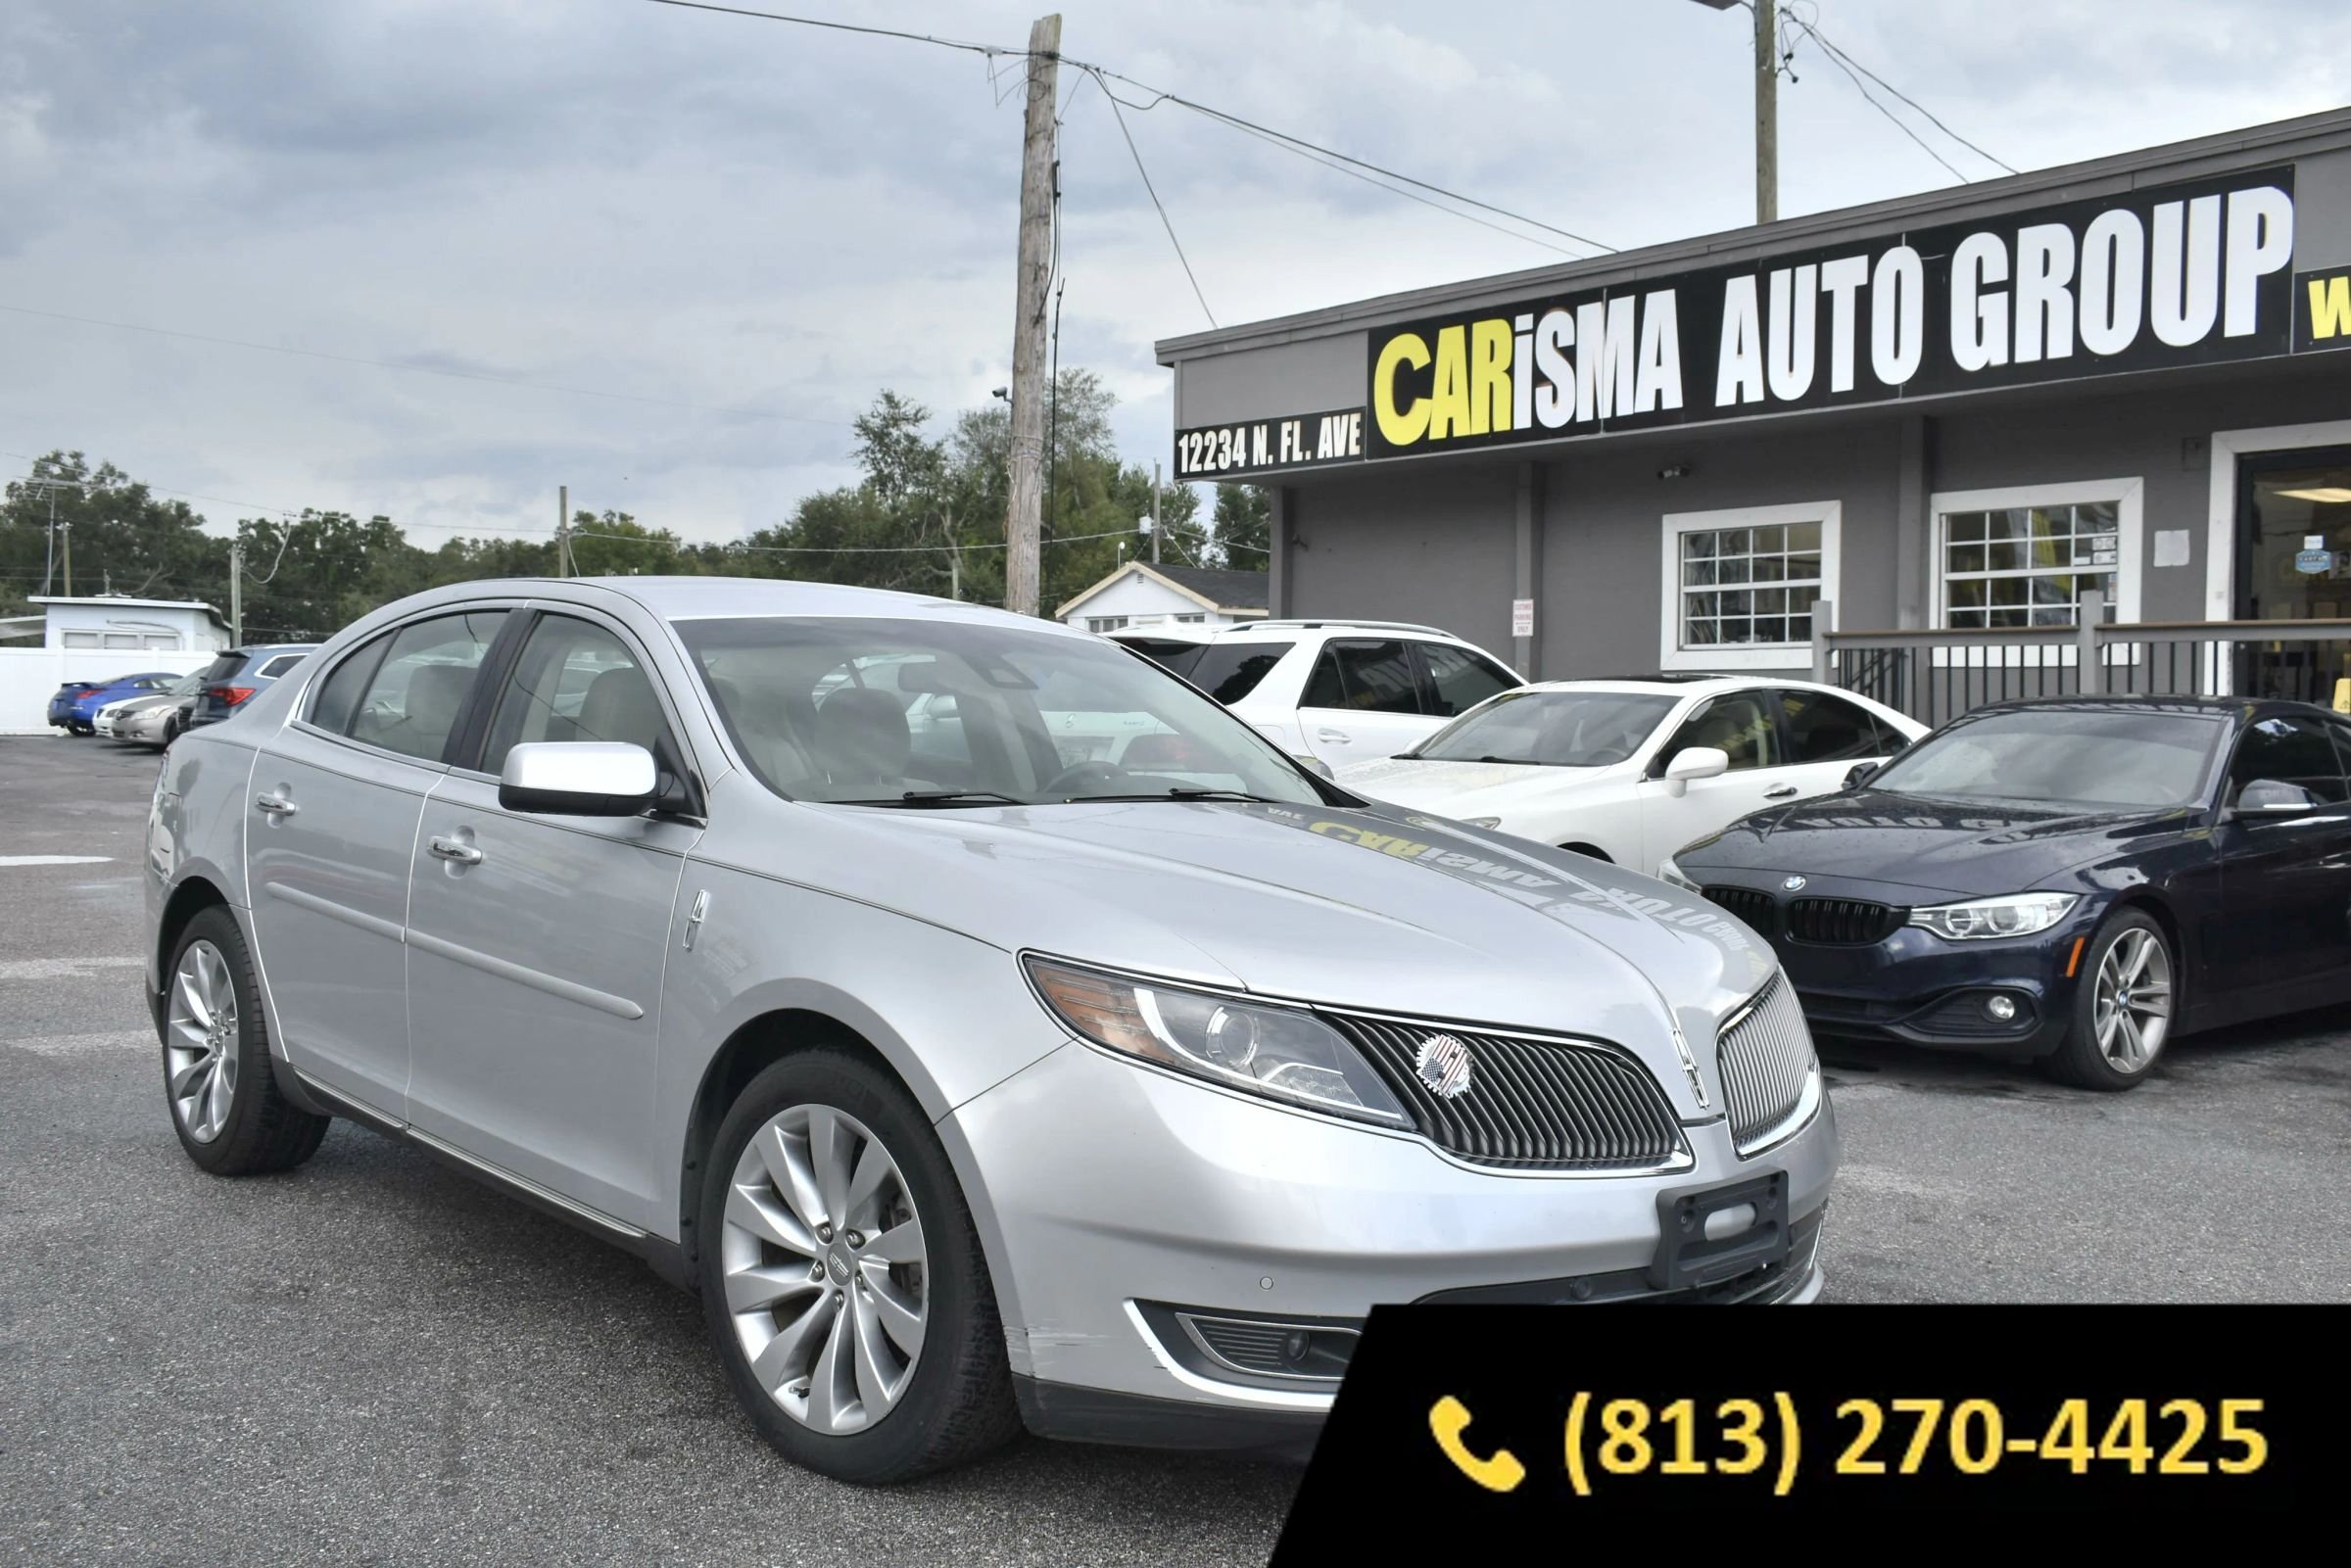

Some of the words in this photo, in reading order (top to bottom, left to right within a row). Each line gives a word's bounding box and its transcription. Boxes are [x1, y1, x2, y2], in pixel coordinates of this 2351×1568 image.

[1374, 289, 1683, 446] CARiSMA
[1715, 245, 1923, 406] AUTO
[1950, 186, 2293, 372] GROUP
[1178, 427, 1246, 473] 12234
[1253, 424, 1272, 466] N.
[1280, 420, 1311, 462] FL.
[1318, 412, 1362, 459] AVE
